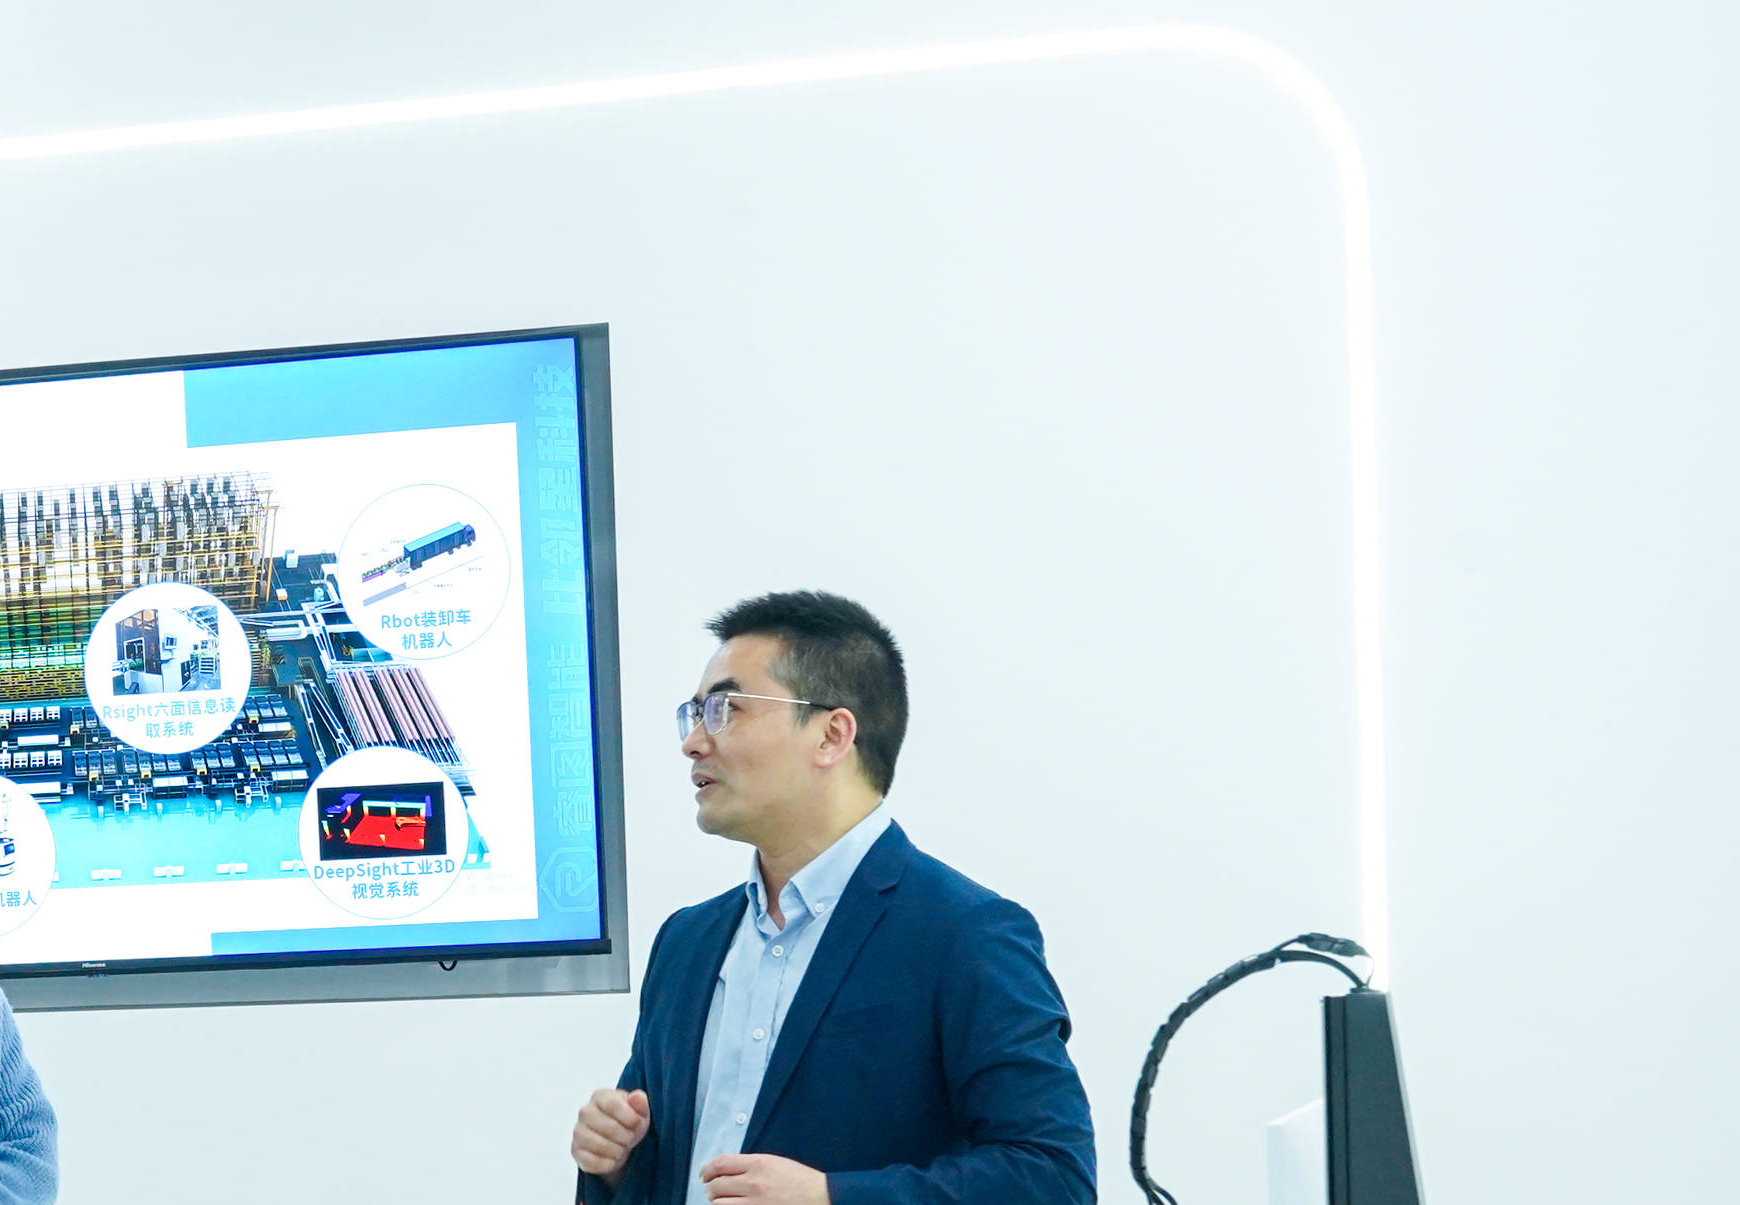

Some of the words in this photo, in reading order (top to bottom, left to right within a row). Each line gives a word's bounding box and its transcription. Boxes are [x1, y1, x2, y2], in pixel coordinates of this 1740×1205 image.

[380, 608, 472, 629] Rbot装卸车
[401, 630, 452, 650] 机器人
[102, 697, 236, 721] Rsight六面信息读
[145, 720, 194, 738] 取系统
[313, 858, 456, 881] DeepSight工业3D
[351, 881, 420, 900] 视觉系统
